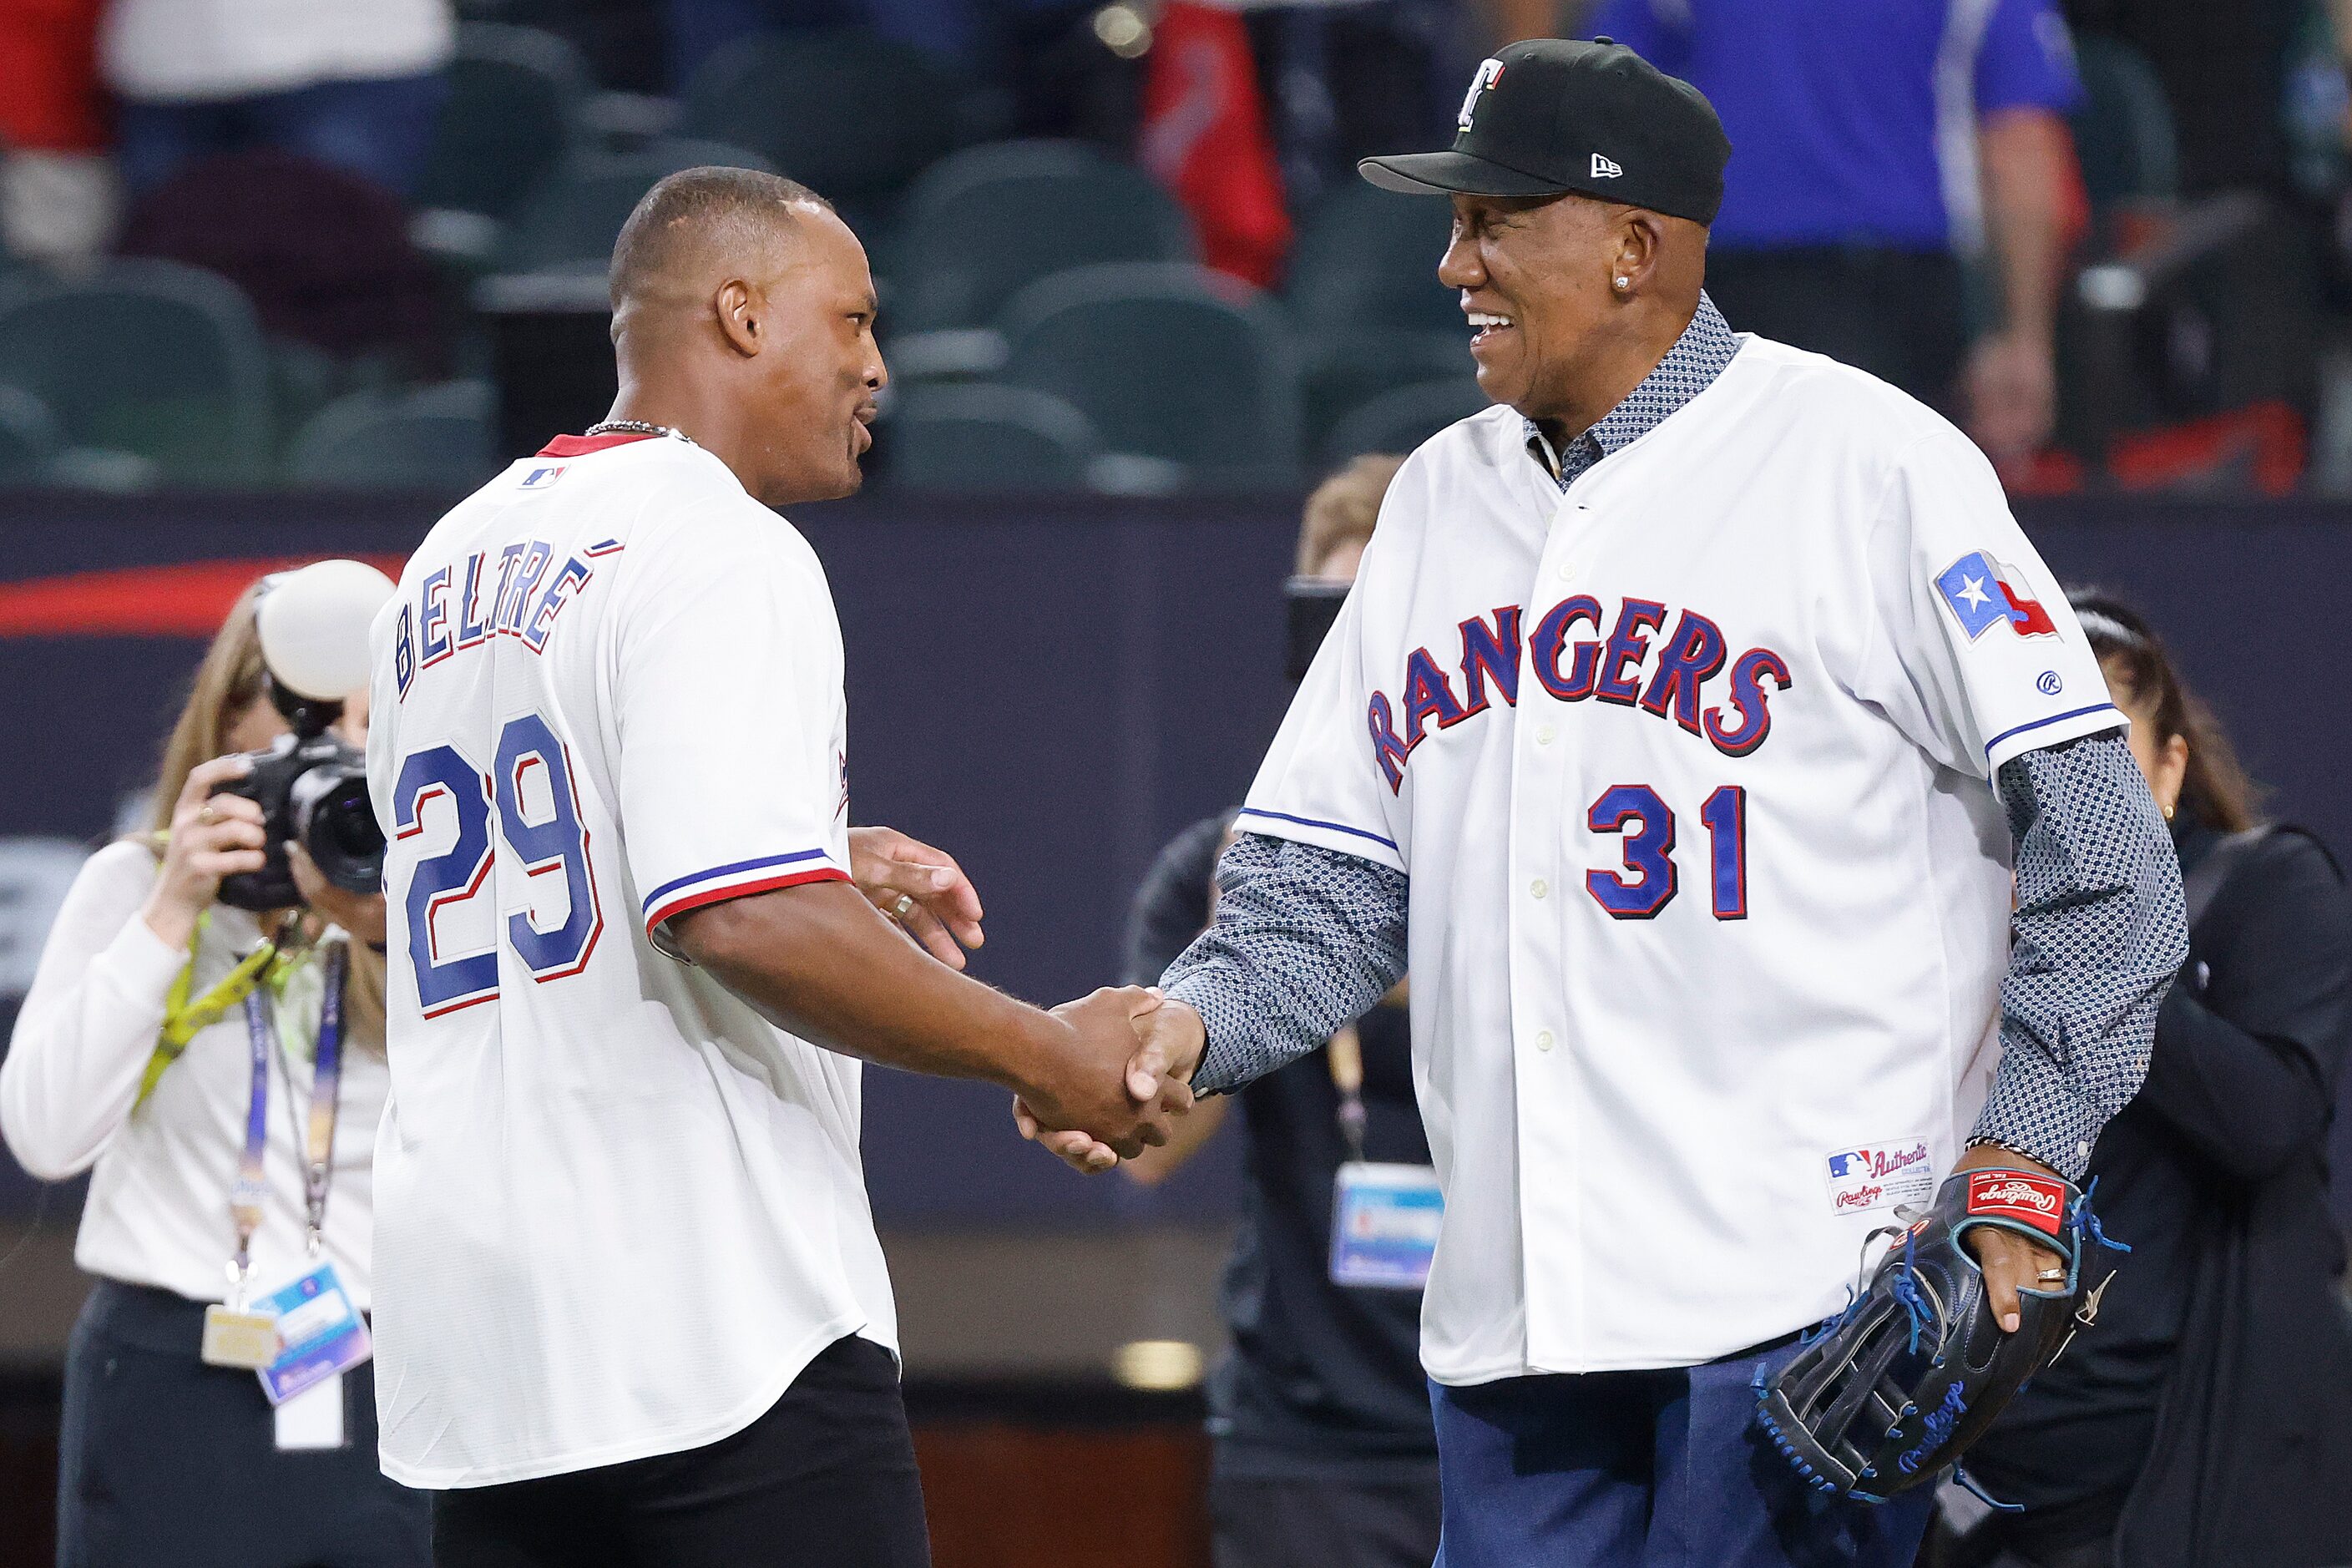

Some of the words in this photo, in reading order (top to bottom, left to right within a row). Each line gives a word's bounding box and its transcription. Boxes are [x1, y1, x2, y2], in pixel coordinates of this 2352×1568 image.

[1458, 58, 1505, 133] T
[1368, 594, 1793, 797] RANGERS
[392, 710, 604, 1019] 29
[1586, 785, 1748, 921] 31
[1837, 1186, 1883, 1207] Rawlings
[1870, 1142, 1927, 1179] Authentic
[1977, 1184, 2056, 1211] Rawlings
